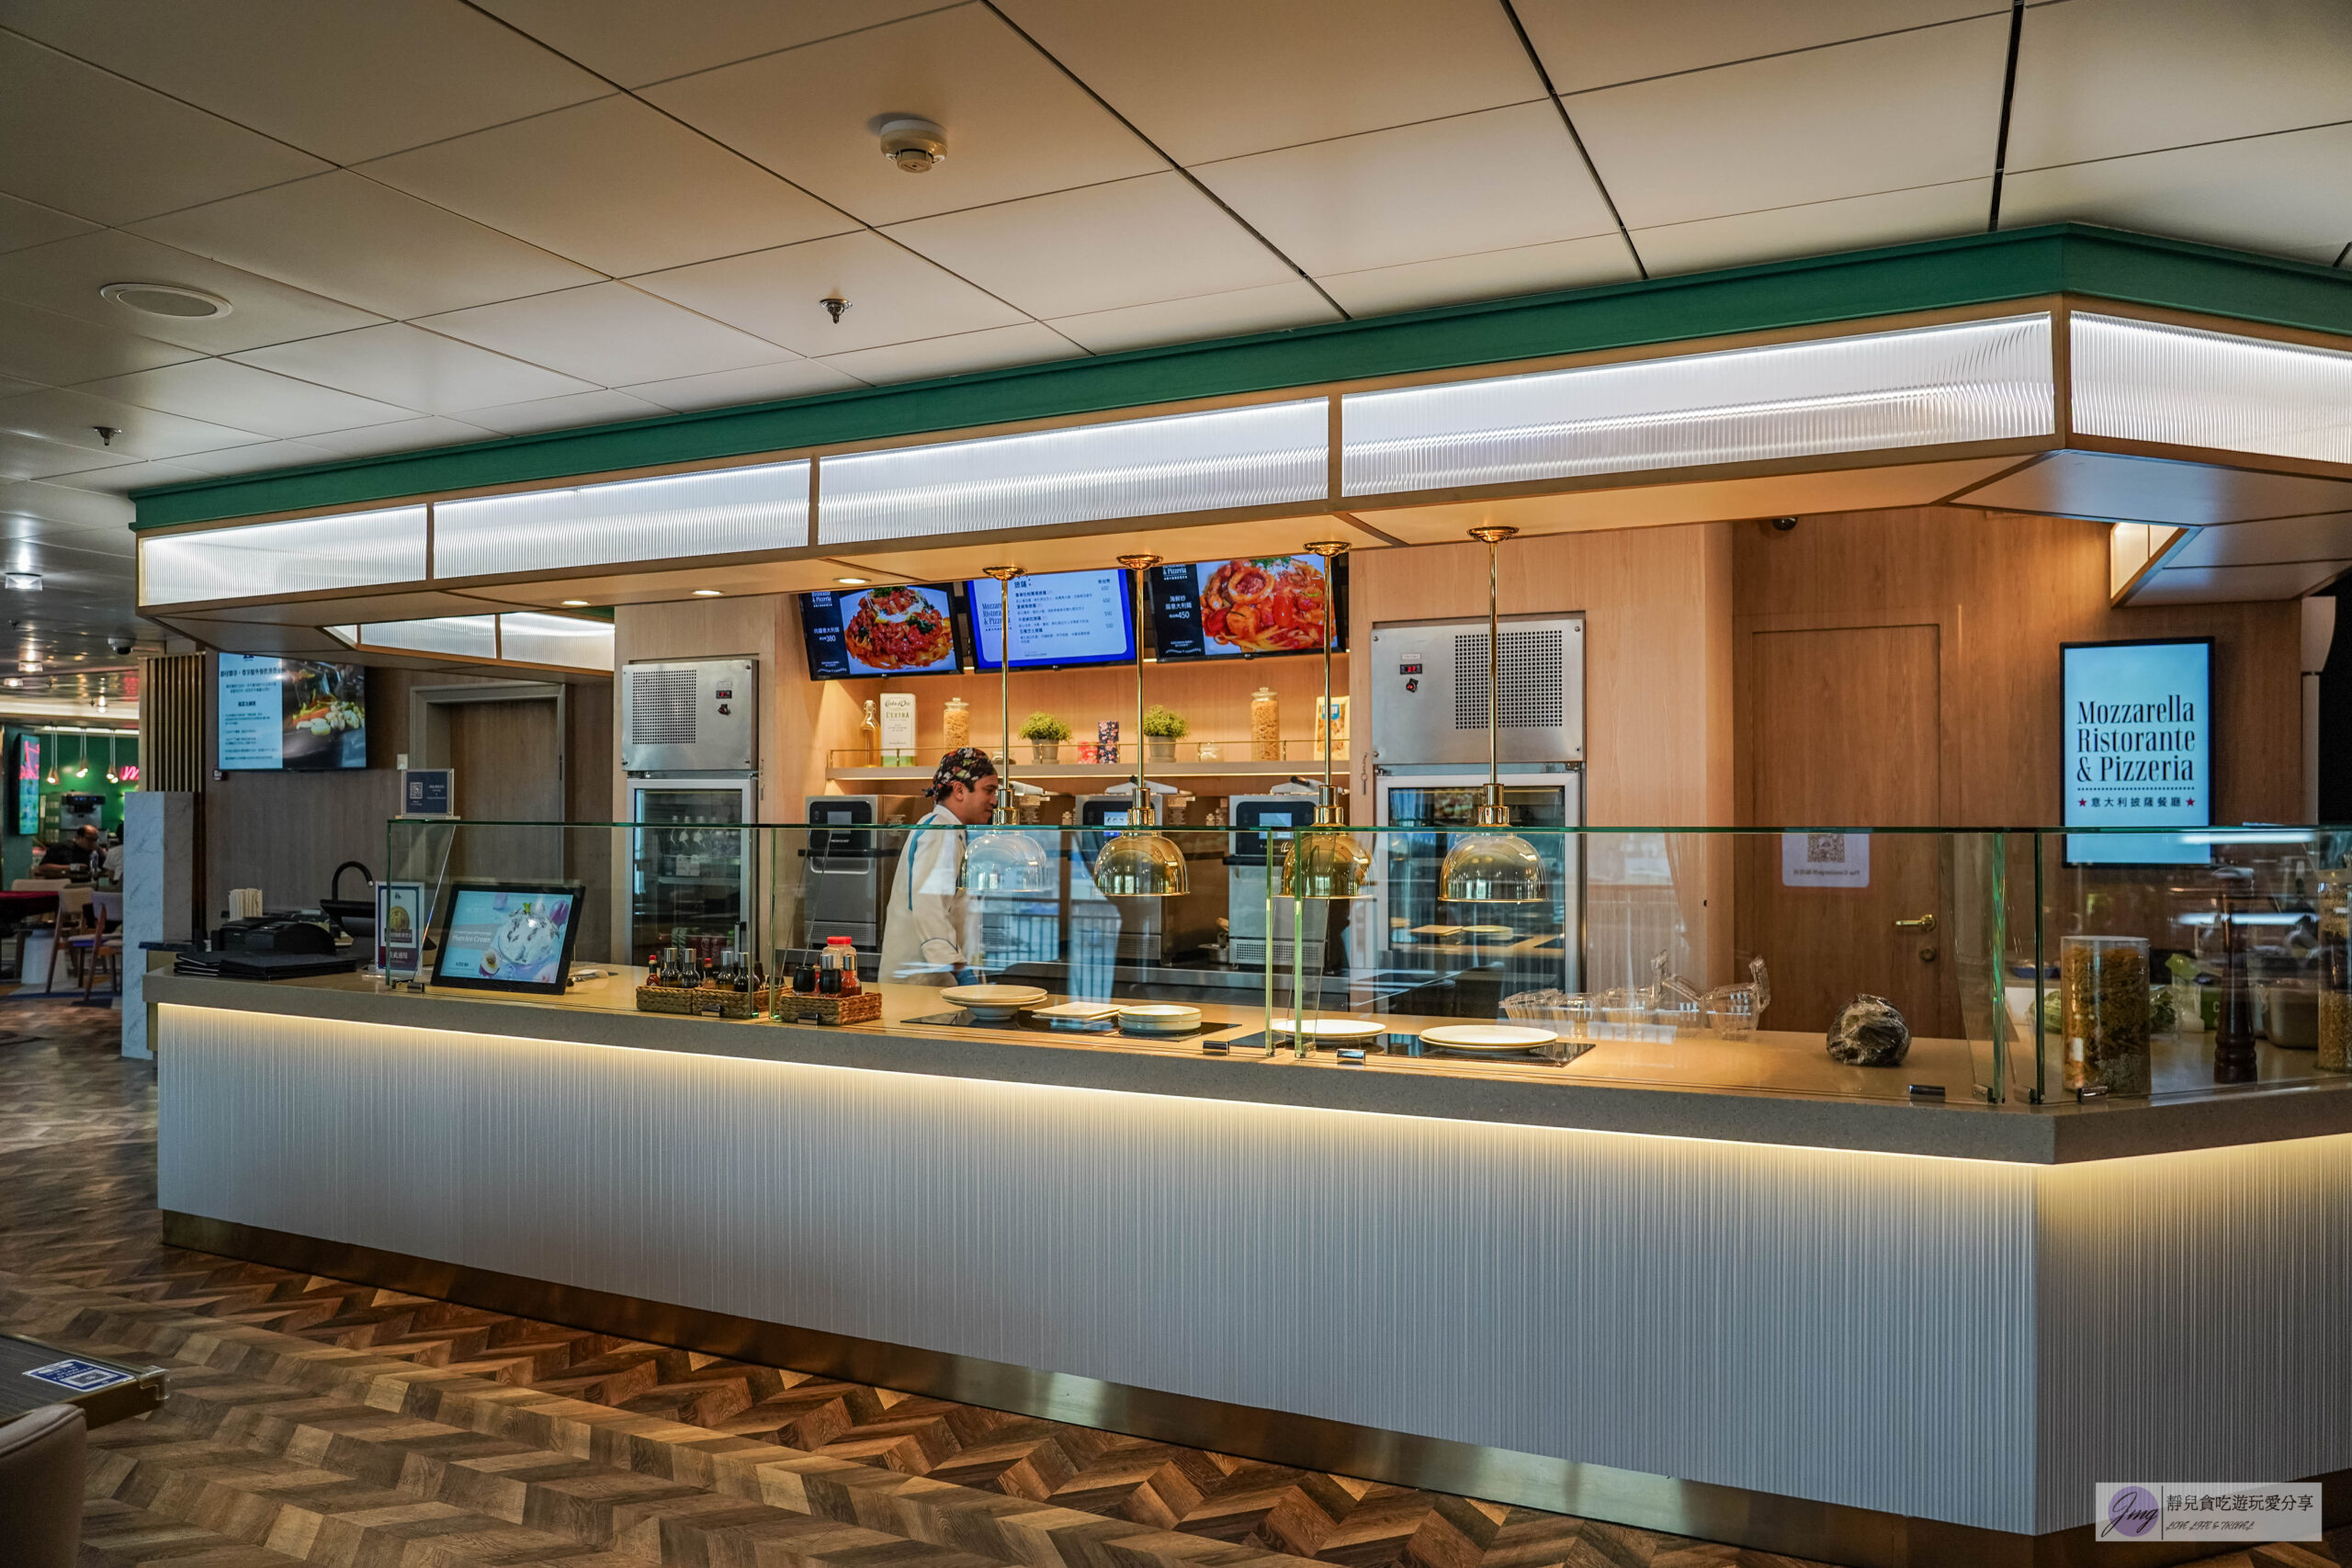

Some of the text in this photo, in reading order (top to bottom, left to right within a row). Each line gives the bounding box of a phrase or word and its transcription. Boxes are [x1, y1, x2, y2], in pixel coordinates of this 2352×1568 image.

[2077, 694, 2195, 725] Mozzarella
[2077, 728, 2195, 752] Ristorante
[2077, 755, 2194, 782] & Pizzeria
[2091, 796, 2182, 808] 意大利披薩餐廳
